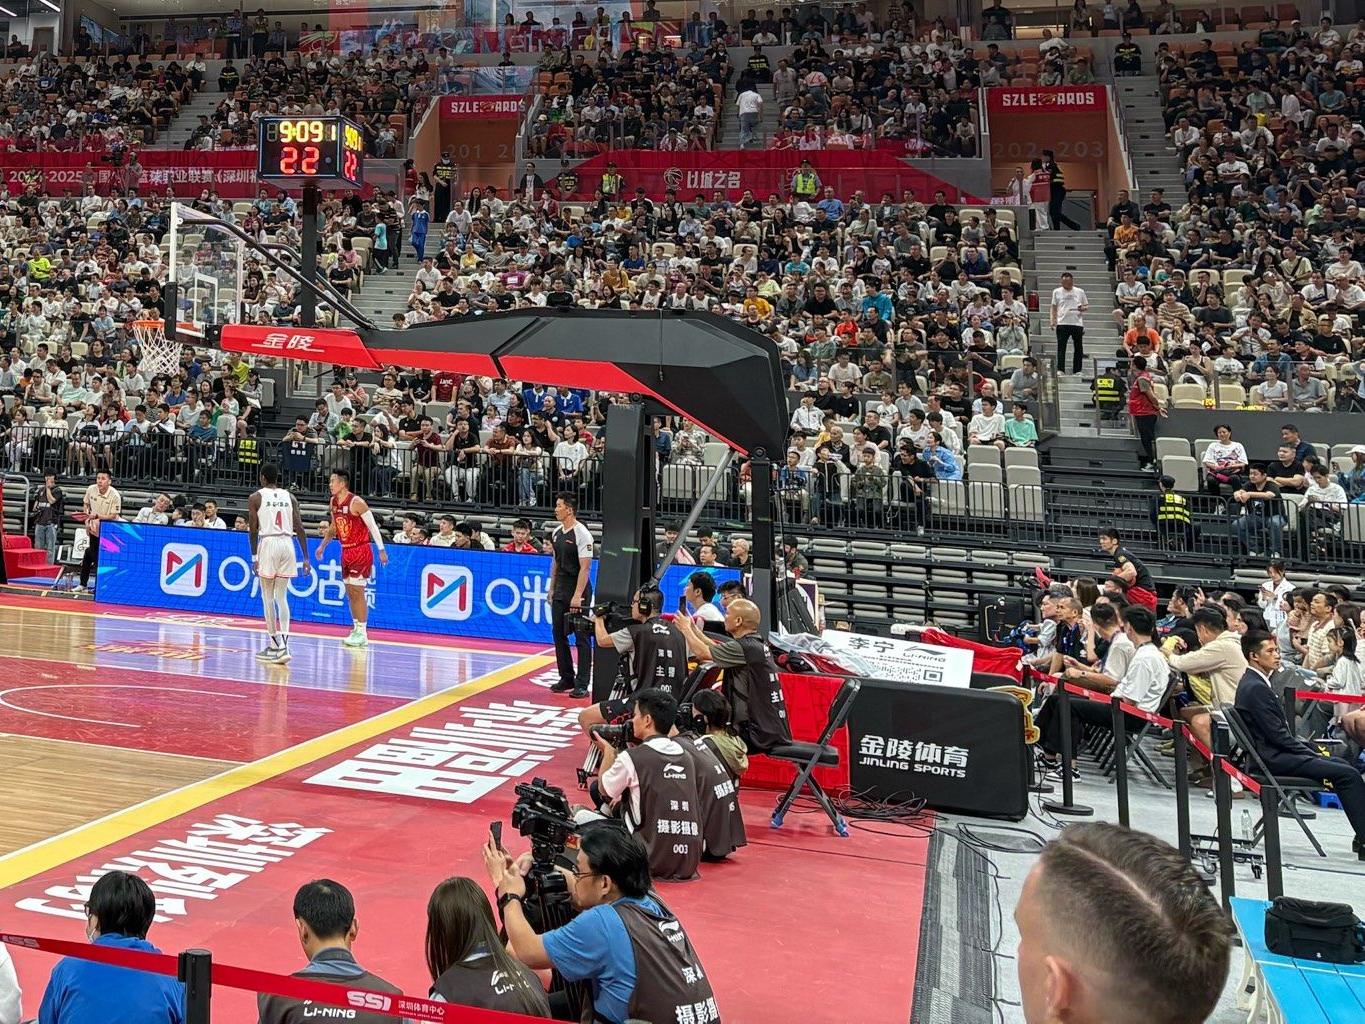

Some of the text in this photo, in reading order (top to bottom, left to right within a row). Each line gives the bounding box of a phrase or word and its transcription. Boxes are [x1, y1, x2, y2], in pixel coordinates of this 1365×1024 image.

[451, 101, 526, 113] SZLEARDS
[1002, 92, 1095, 106] SZLEARDS
[279, 121, 324, 143] 9:09
[280, 146, 320, 174] 22
[686, 170, 741, 189] 以城之名
[251, 333, 325, 353] 金陵
[275, 510, 283, 529] 4
[848, 636, 895, 653] 李宁
[859, 734, 969, 768] 金陵体育
[859, 757, 966, 778] JINLING SPORTS
[672, 844, 689, 854] 003
[304, 1006, 356, 1019] LI-NING
[346, 990, 392, 1011] SSI
[398, 999, 446, 1016] 深圳体育中心
